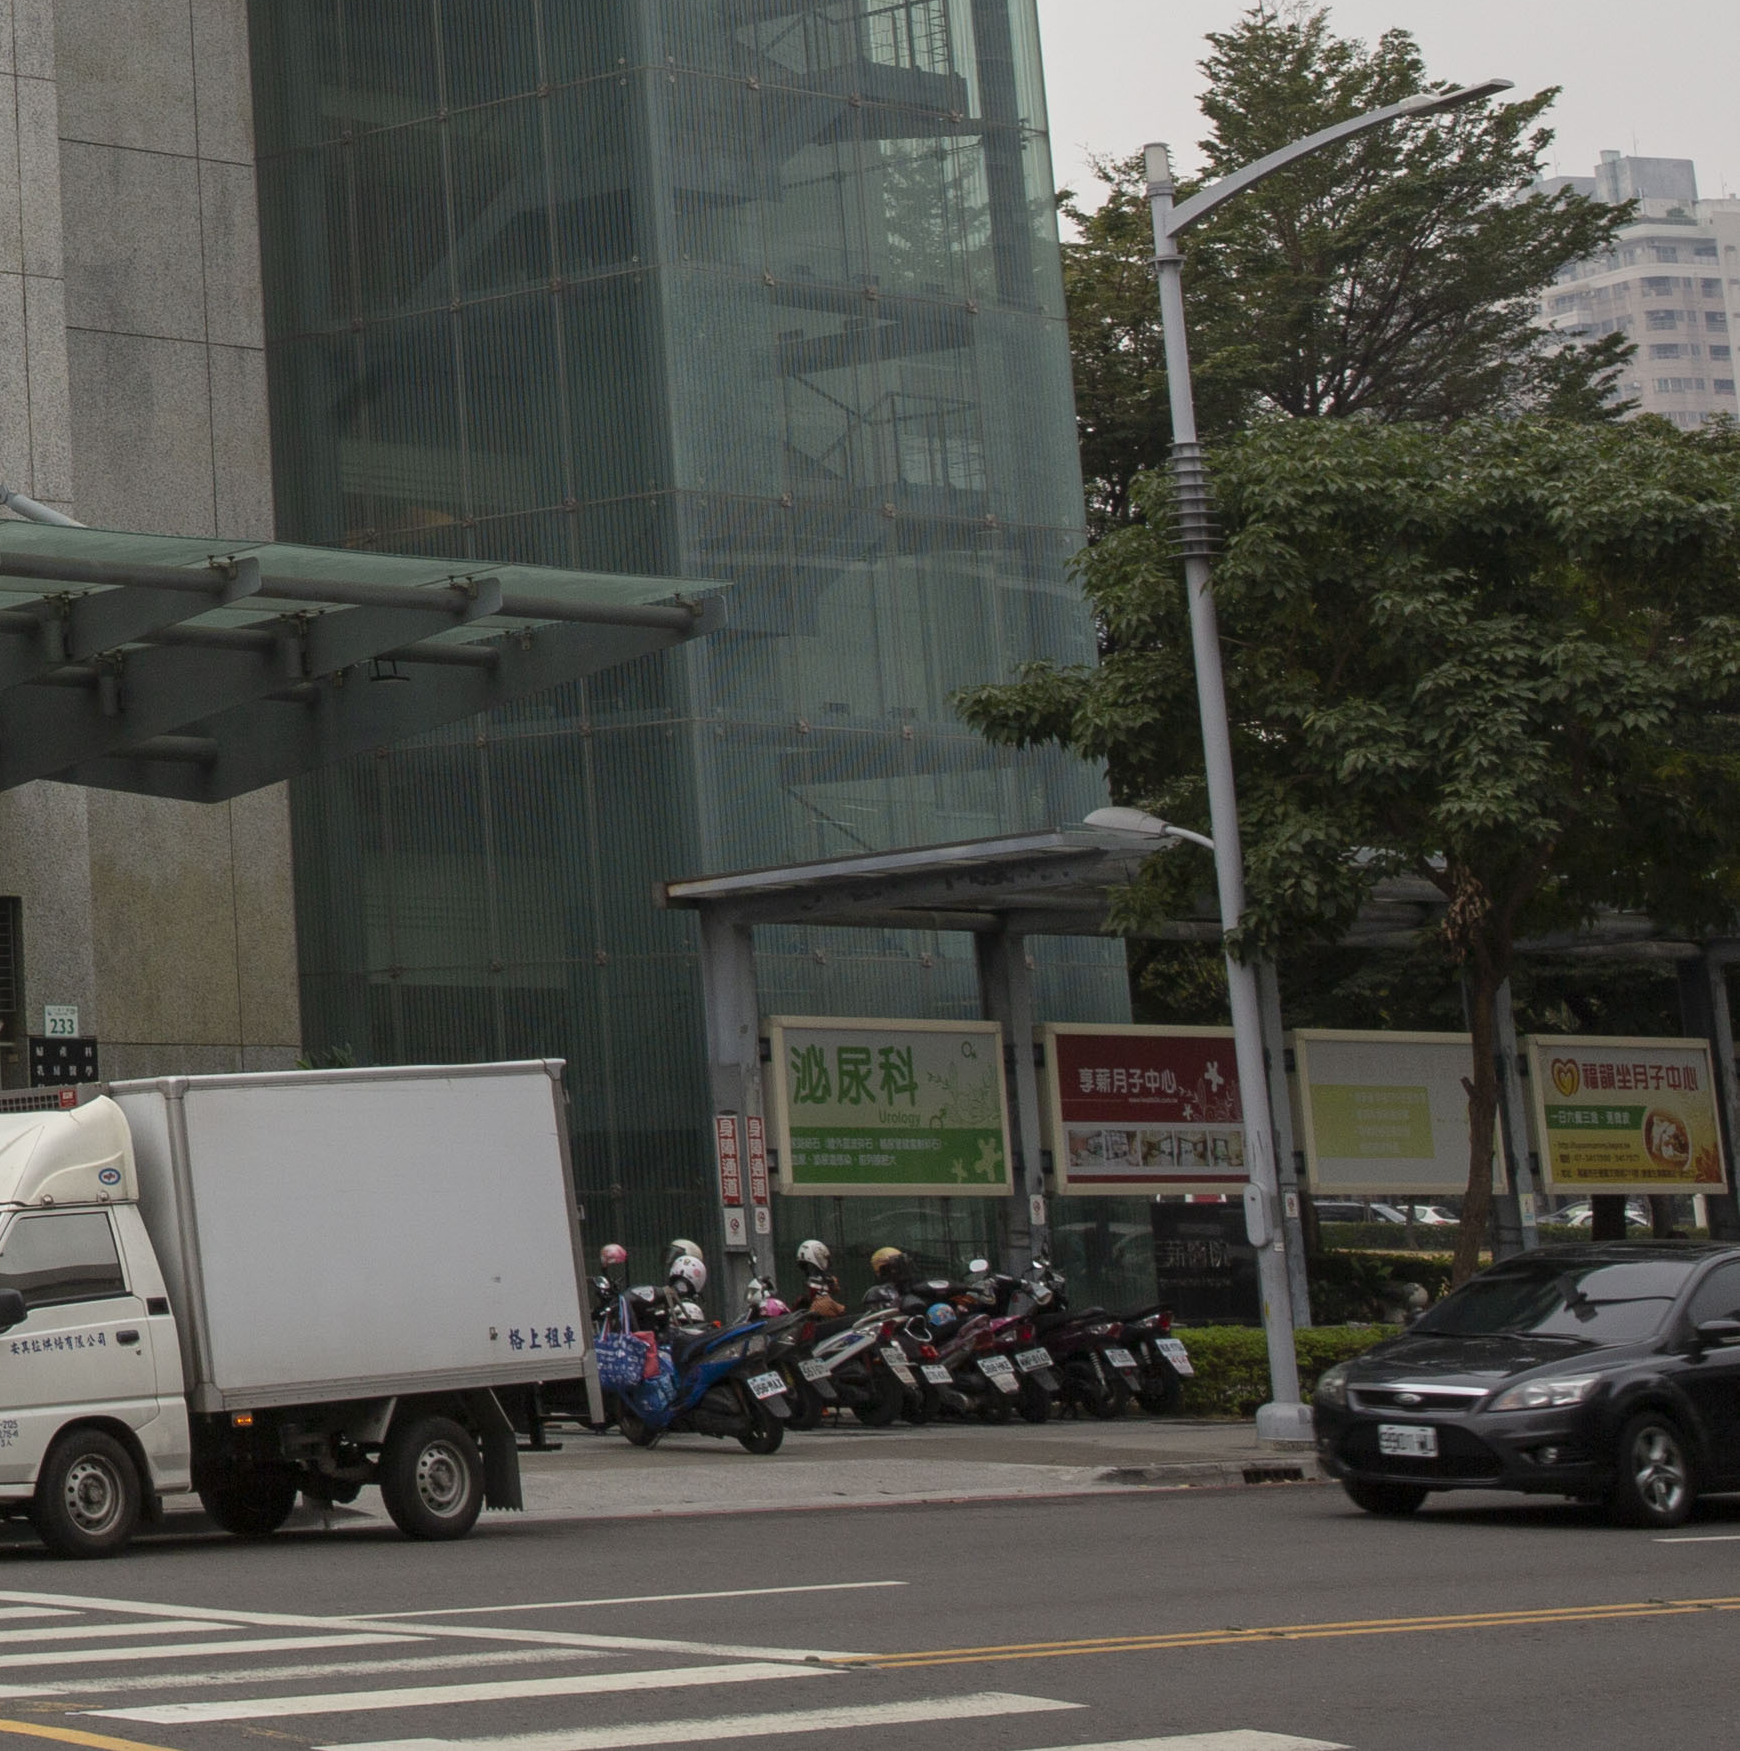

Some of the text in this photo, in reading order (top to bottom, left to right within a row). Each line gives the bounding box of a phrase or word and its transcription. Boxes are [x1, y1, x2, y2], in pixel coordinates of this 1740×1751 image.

[50, 1018, 74, 1035] 233
[790, 1045, 918, 1107] 泌尿科
[879, 1108, 921, 1127] Urology
[508, 1325, 576, 1351] 格上租車
